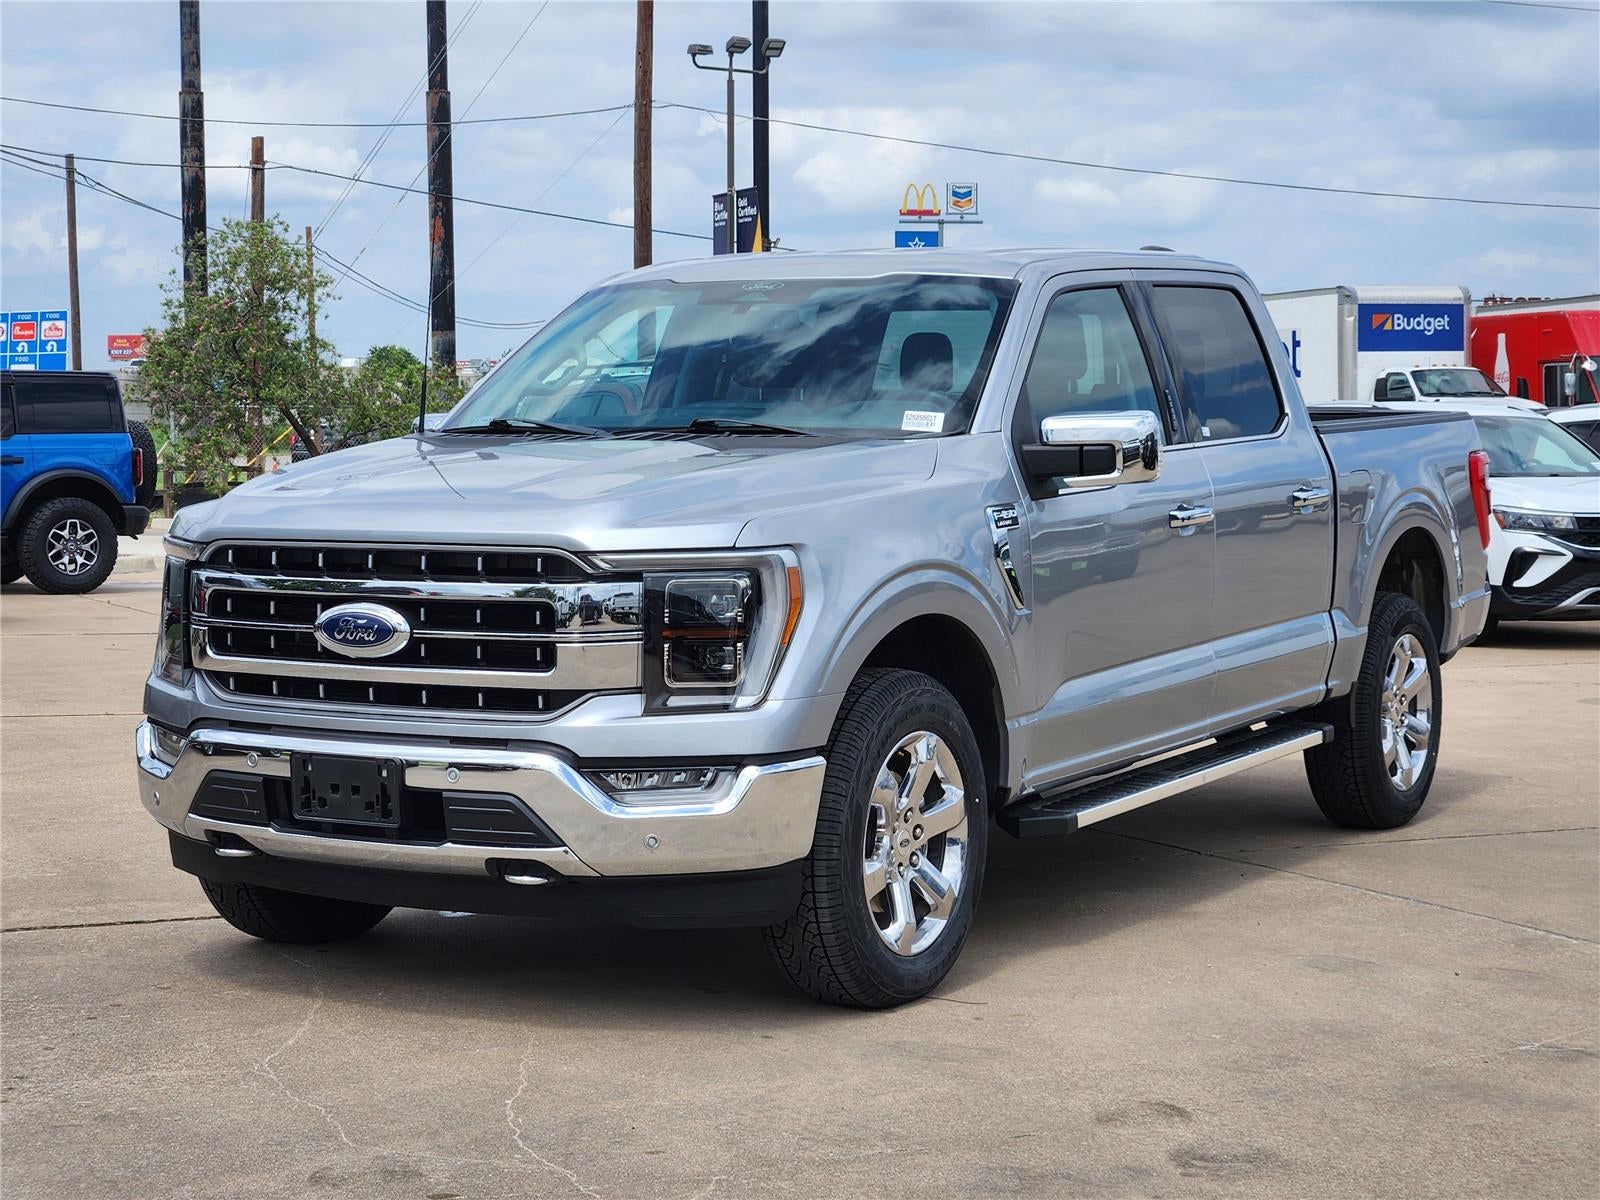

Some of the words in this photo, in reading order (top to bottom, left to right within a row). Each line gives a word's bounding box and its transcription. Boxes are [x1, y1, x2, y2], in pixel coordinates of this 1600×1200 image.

[714, 202, 724, 211] Blue
[738, 197, 748, 207] Gold
[714, 210, 728, 221] Certifie
[738, 205, 757, 217] Certified
[1394, 313, 1450, 335] Budget
[334, 617, 378, 641] Ford
